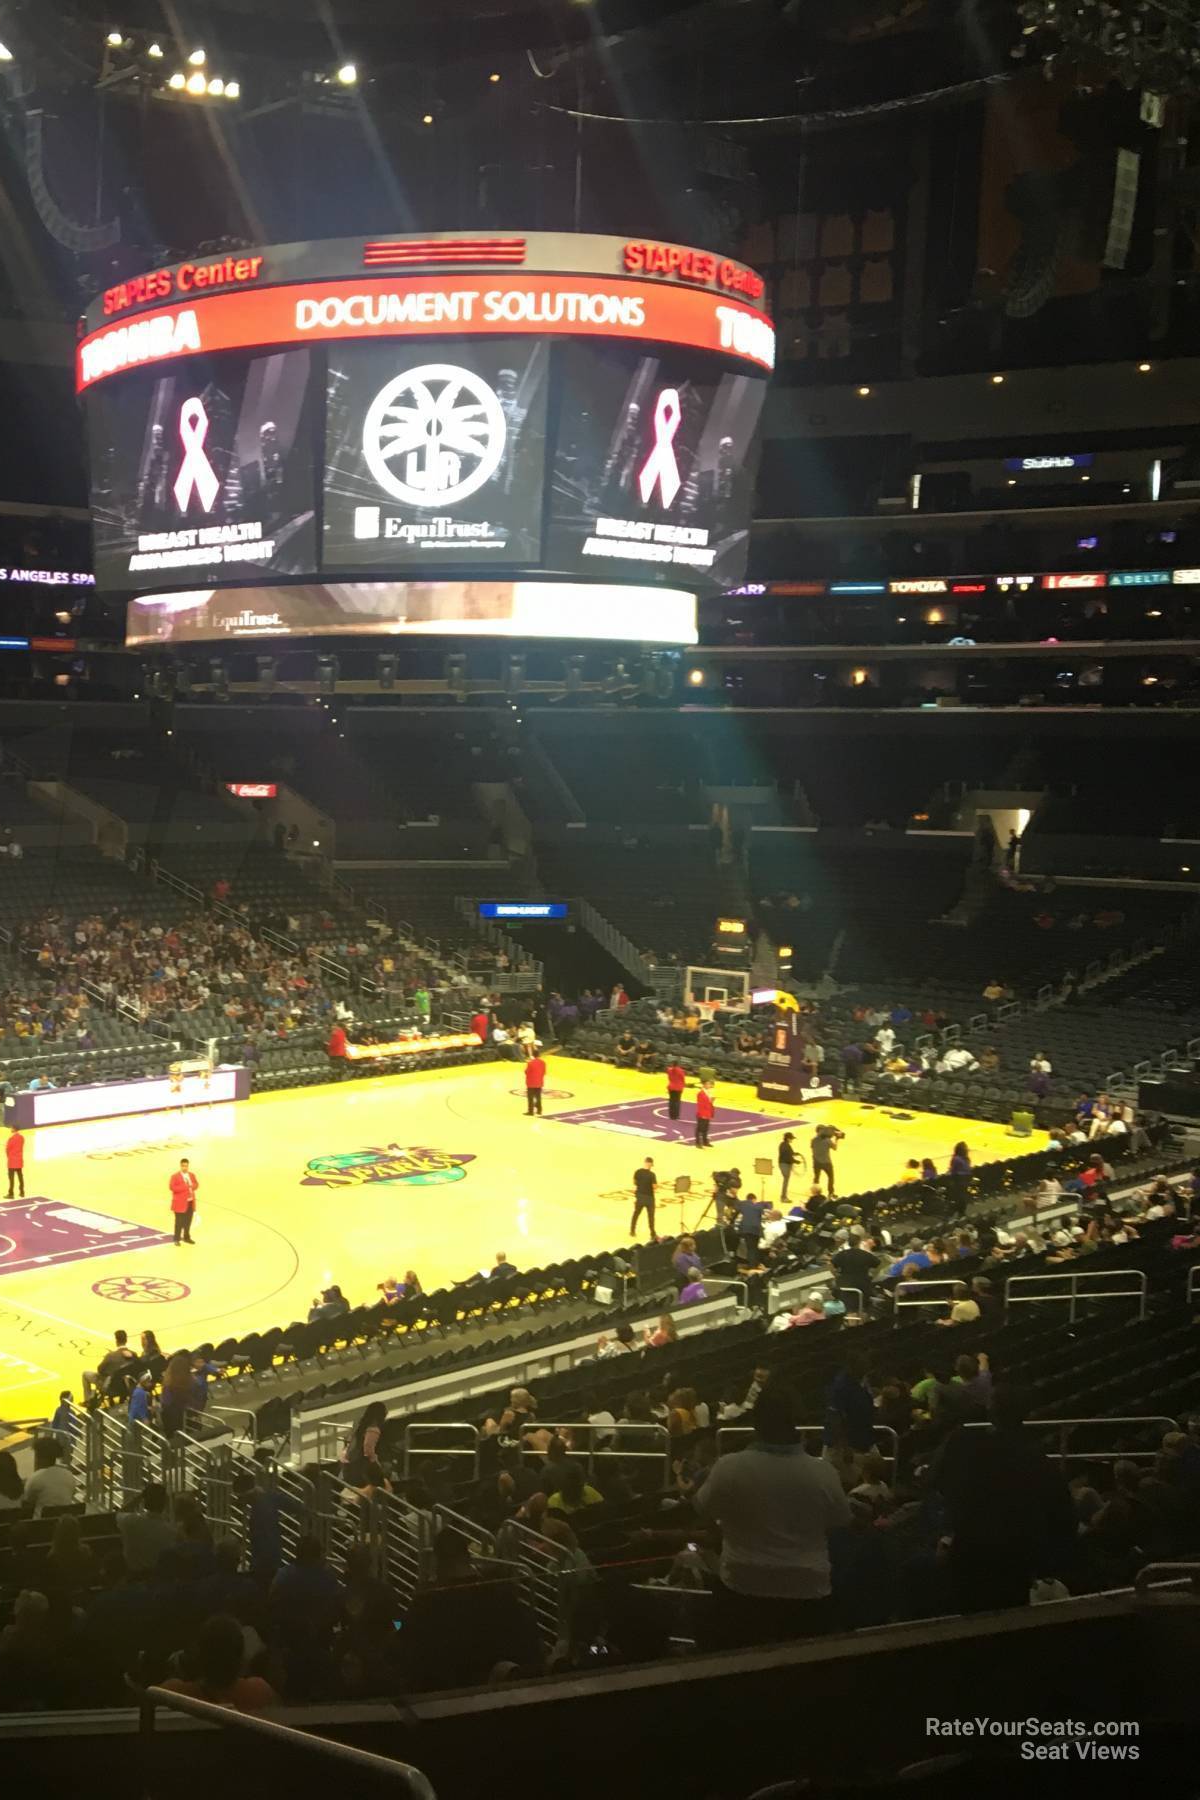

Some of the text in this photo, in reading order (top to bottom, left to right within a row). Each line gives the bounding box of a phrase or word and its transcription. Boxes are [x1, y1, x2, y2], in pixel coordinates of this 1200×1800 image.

[623, 240, 717, 282] STAPLES
[103, 256, 263, 315] STAPLES Center
[295, 290, 646, 330] DOCUMENT SOLUTIONS
[1022, 456, 1075, 469] StubHub
[138, 521, 262, 552] BREAST HEALTH
[10, 570, 69, 585] ANGELES
[889, 580, 947, 593] TOYOTA
[1124, 574, 1170, 584] DELTA
